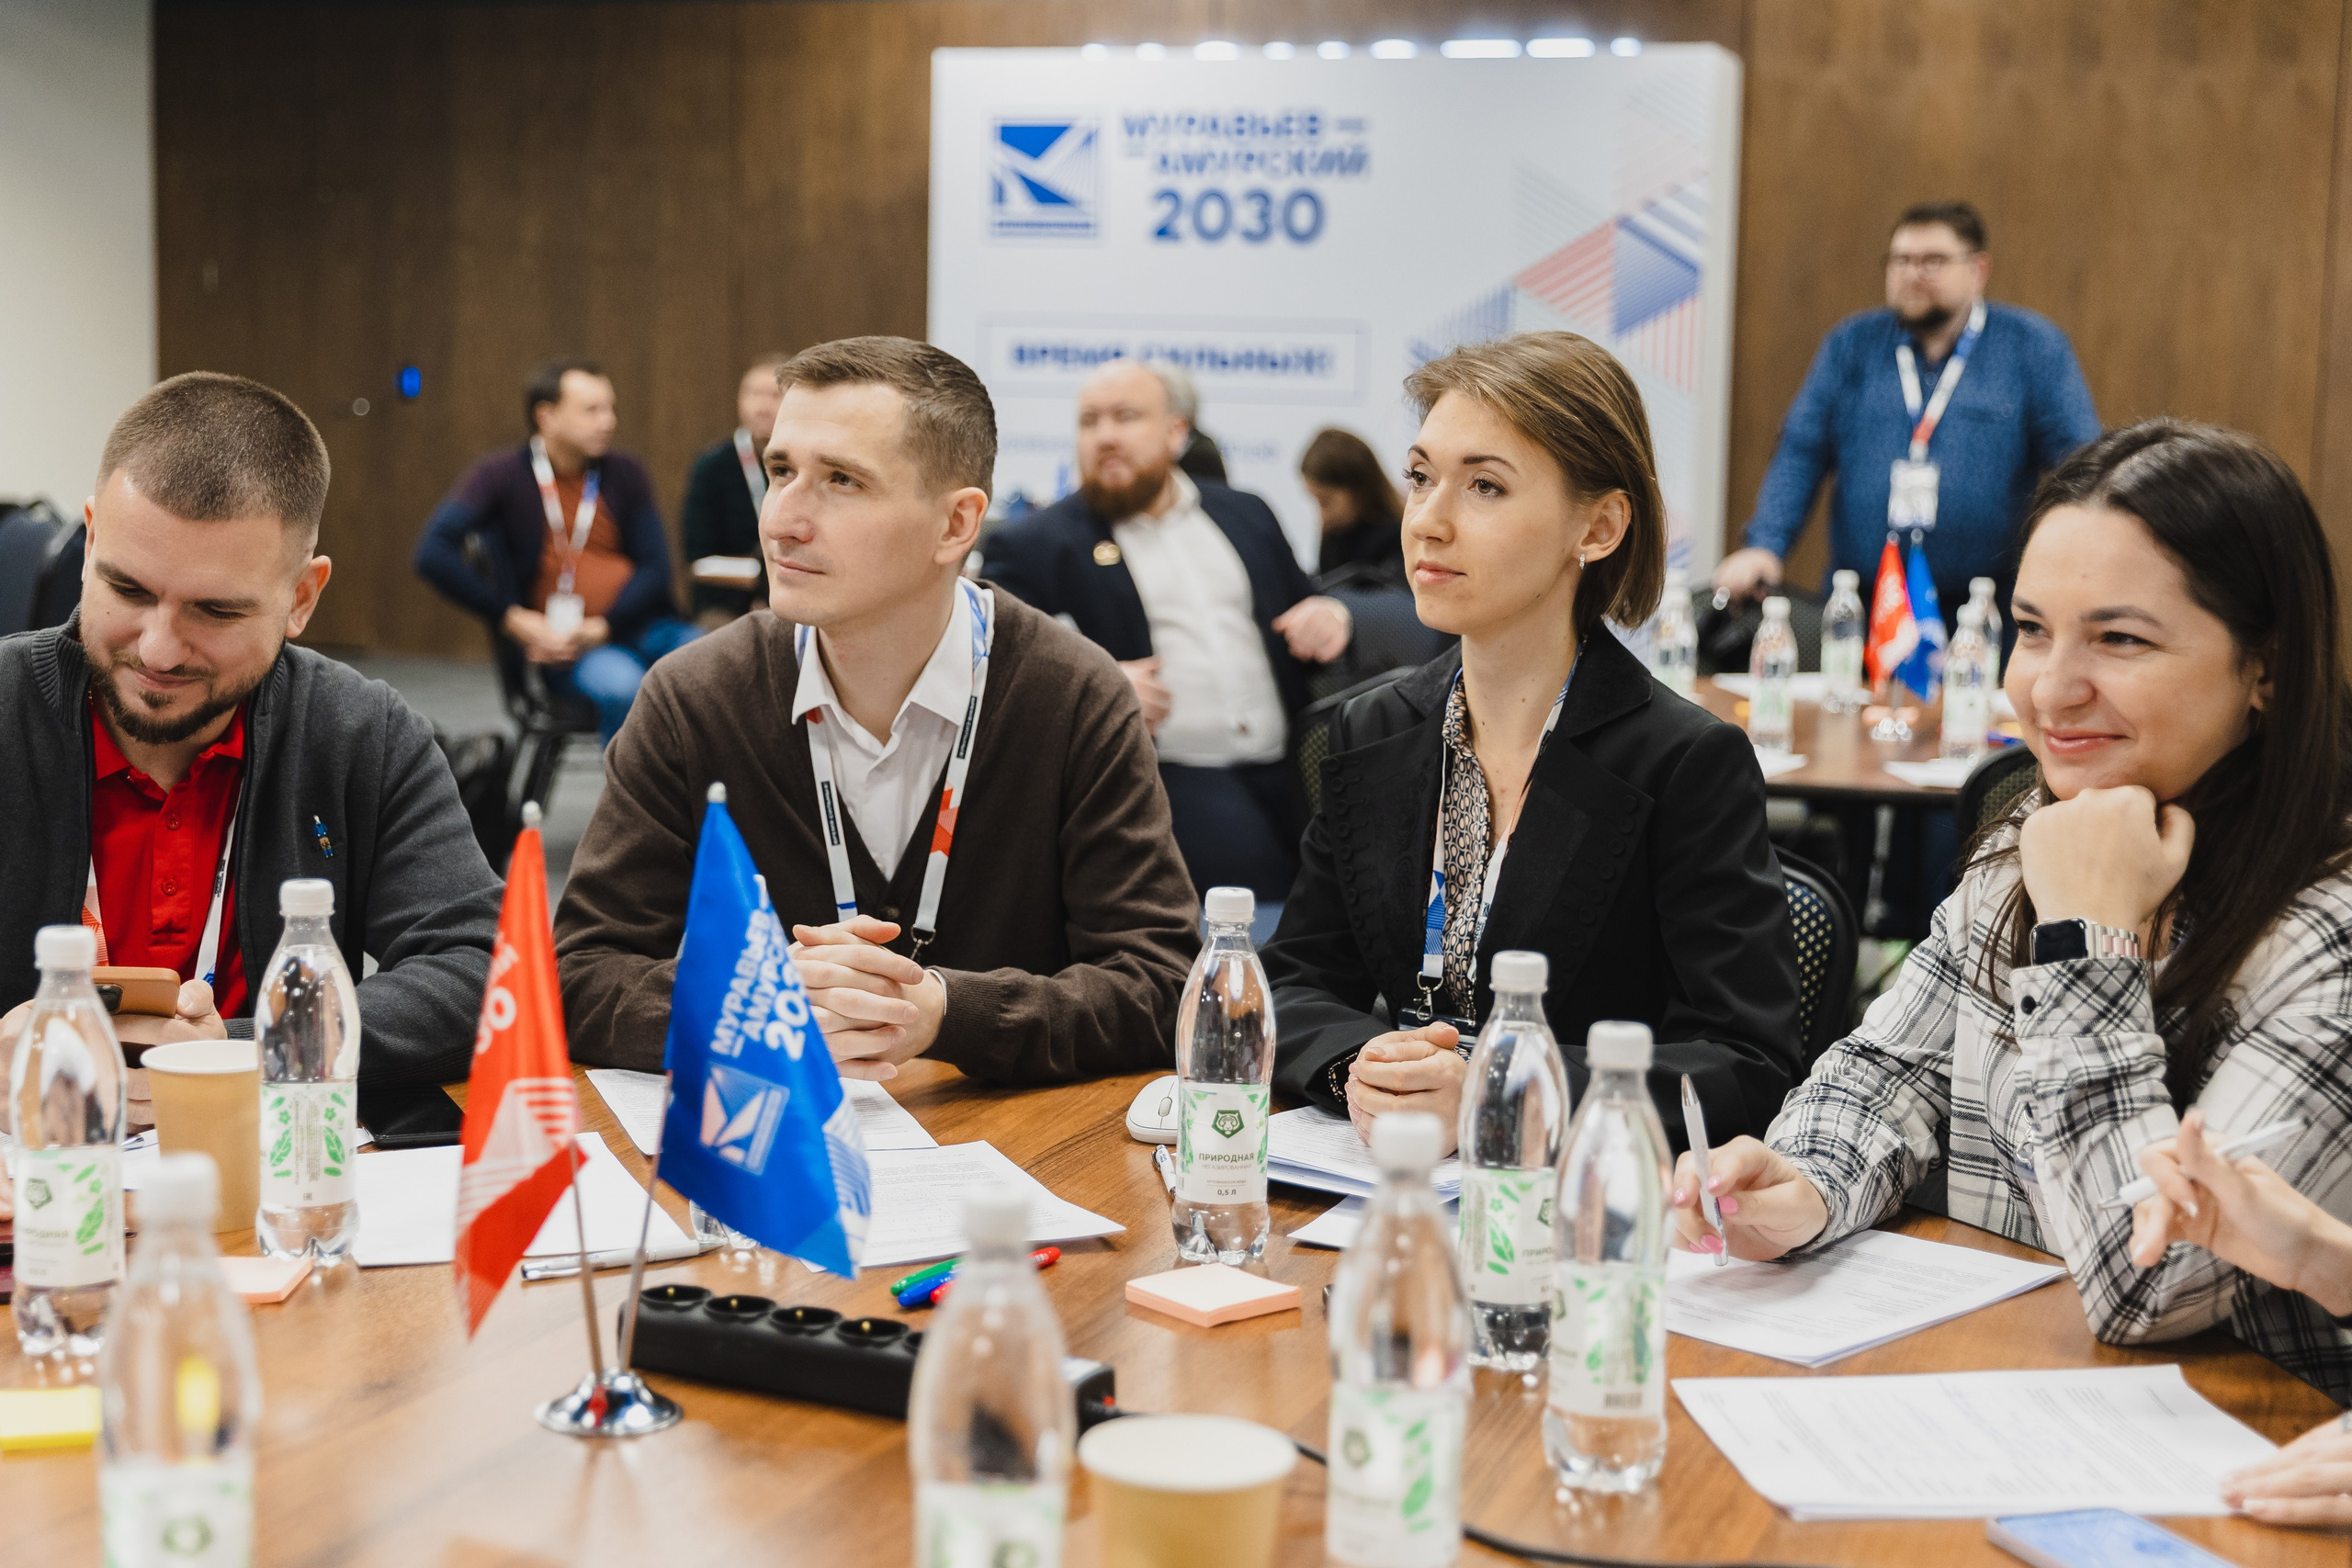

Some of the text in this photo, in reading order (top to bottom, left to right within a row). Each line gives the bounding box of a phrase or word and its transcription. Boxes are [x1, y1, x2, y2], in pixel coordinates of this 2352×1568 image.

[1149, 186, 1326, 243] 2030
[709, 908, 772, 1056] МУРАВЬЕВ
[763, 963, 809, 1062] 203
[1198, 1152, 1255, 1164] ПРИРОДНАЯ
[1216, 1189, 1229, 1197] 0,5
